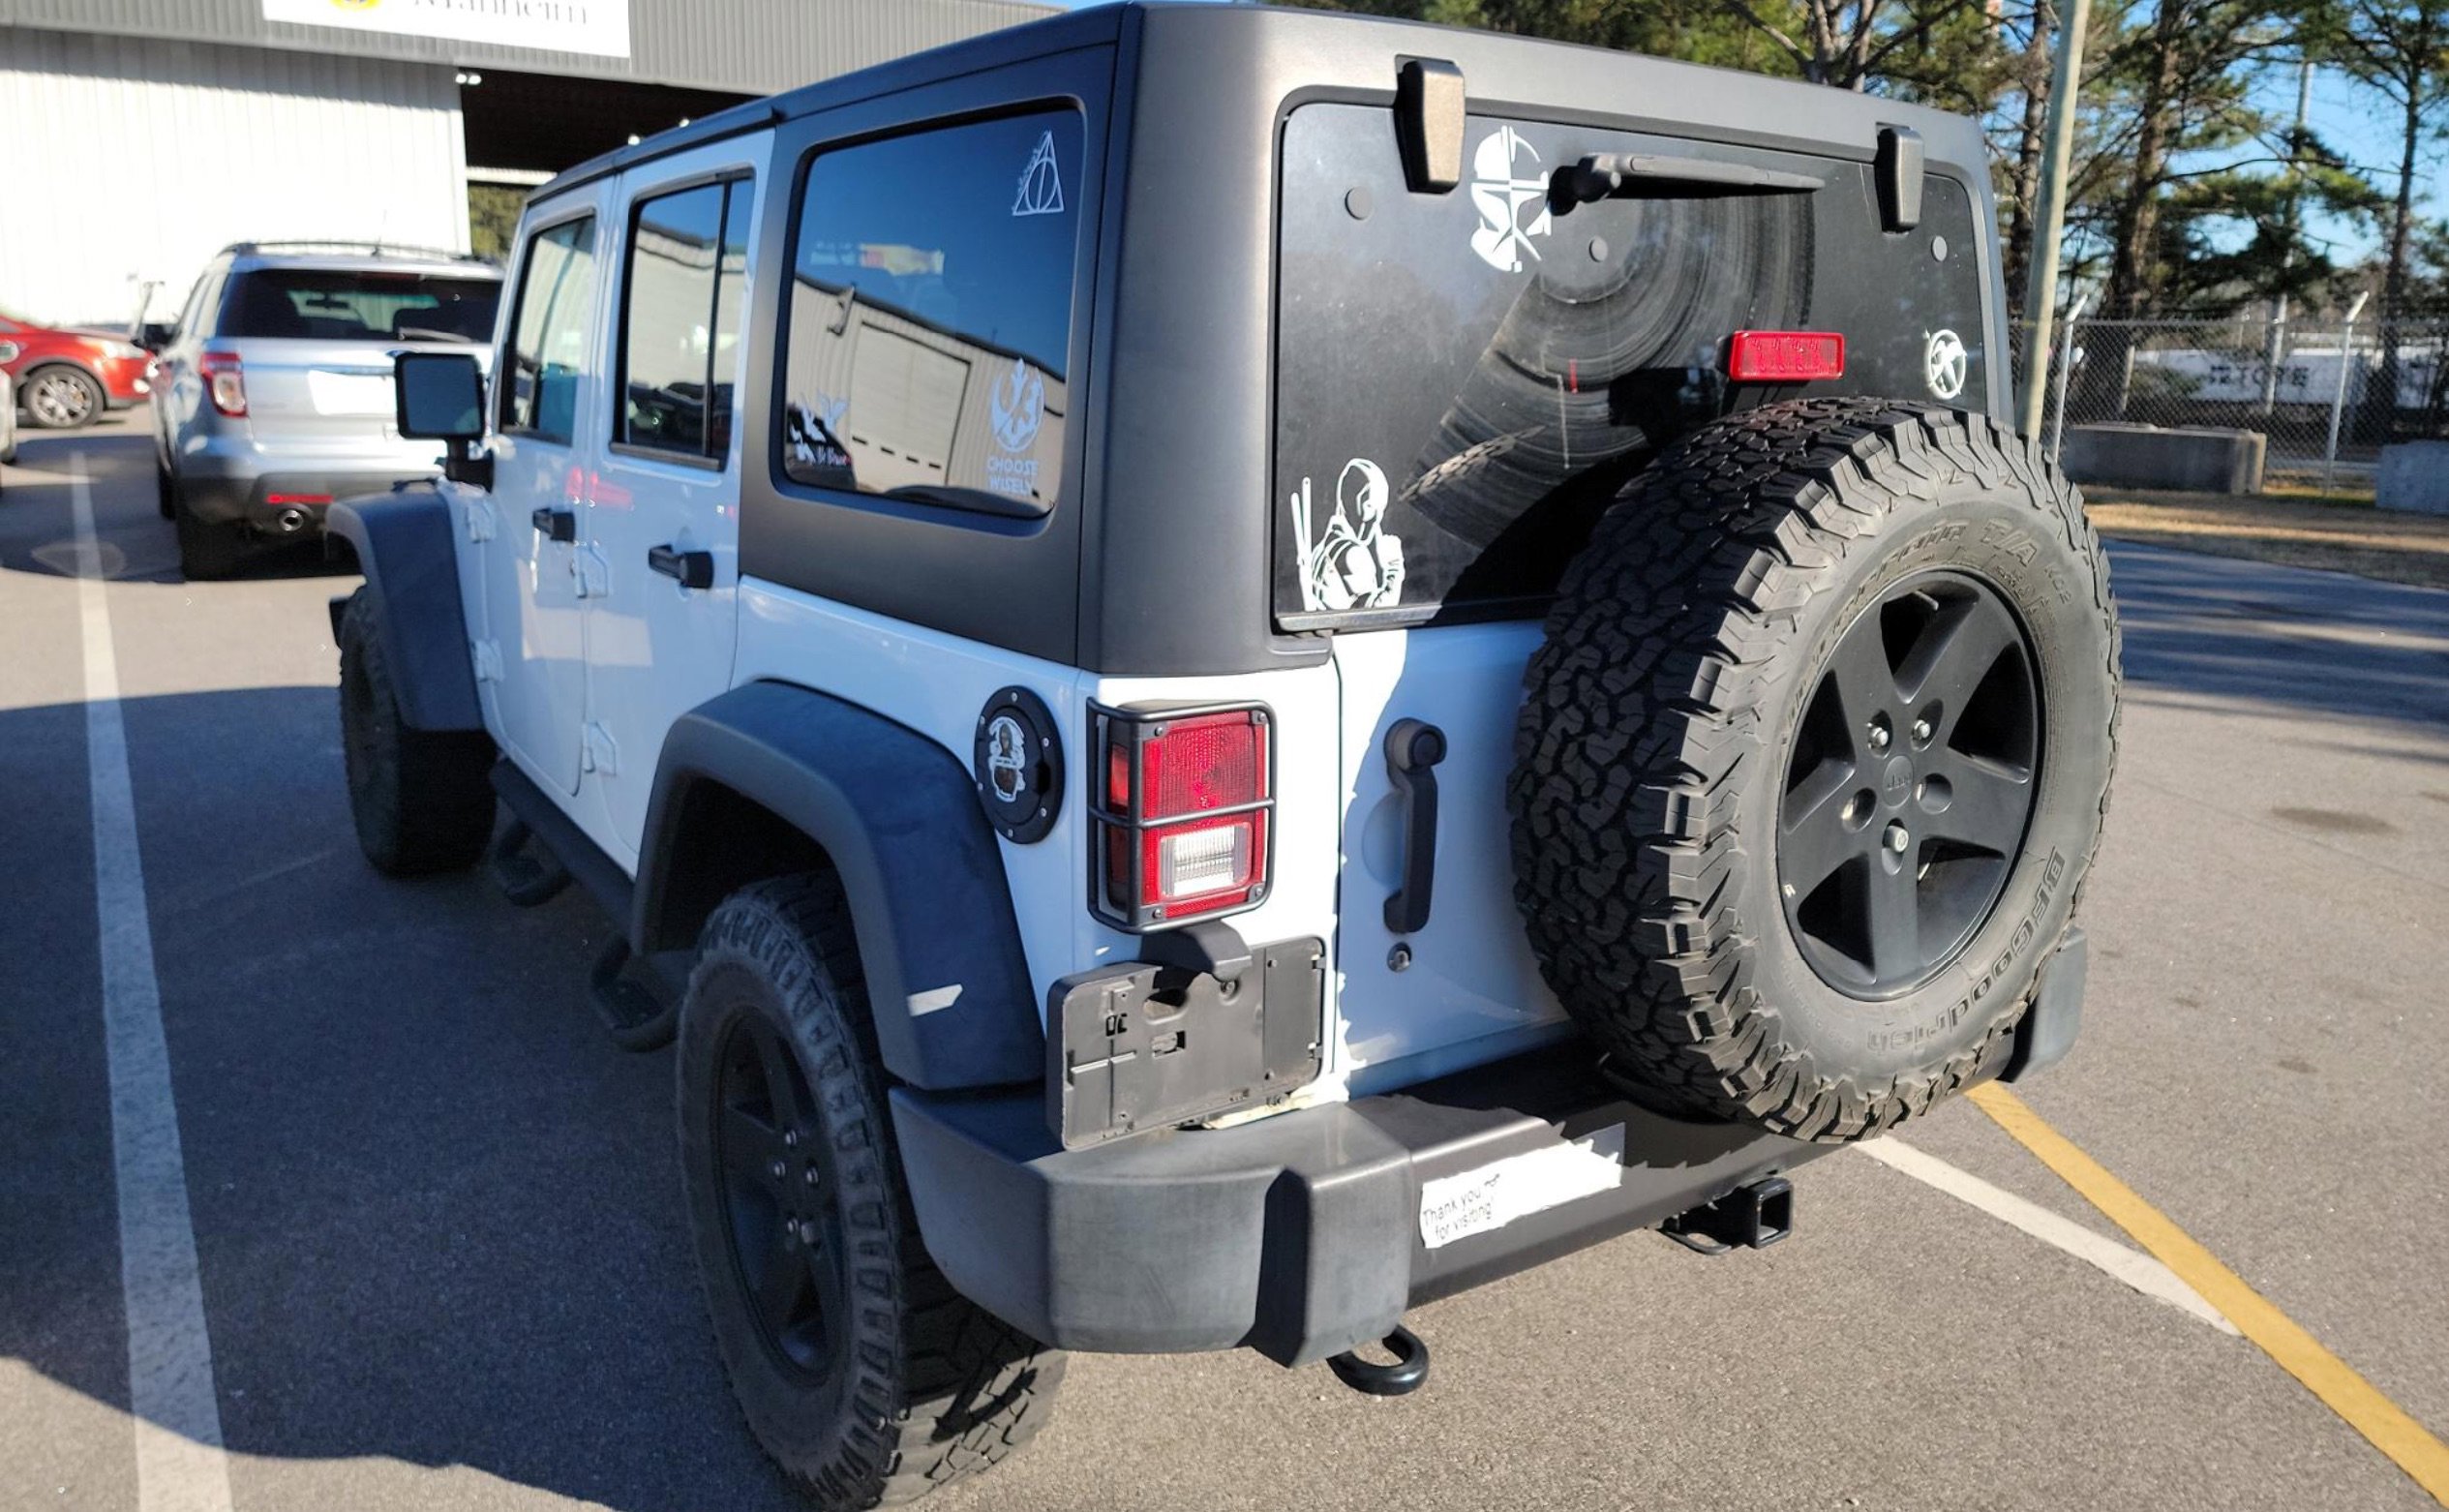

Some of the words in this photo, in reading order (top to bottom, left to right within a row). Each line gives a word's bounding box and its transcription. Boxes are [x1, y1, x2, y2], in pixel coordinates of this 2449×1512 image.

[987, 455, 1039, 475] CHOOSE
[1866, 845, 2066, 1053] BFGoodrich
[1423, 1197, 1458, 1226] Thank
[1461, 1187, 1481, 1212] you
[1435, 1224, 1450, 1240] for
